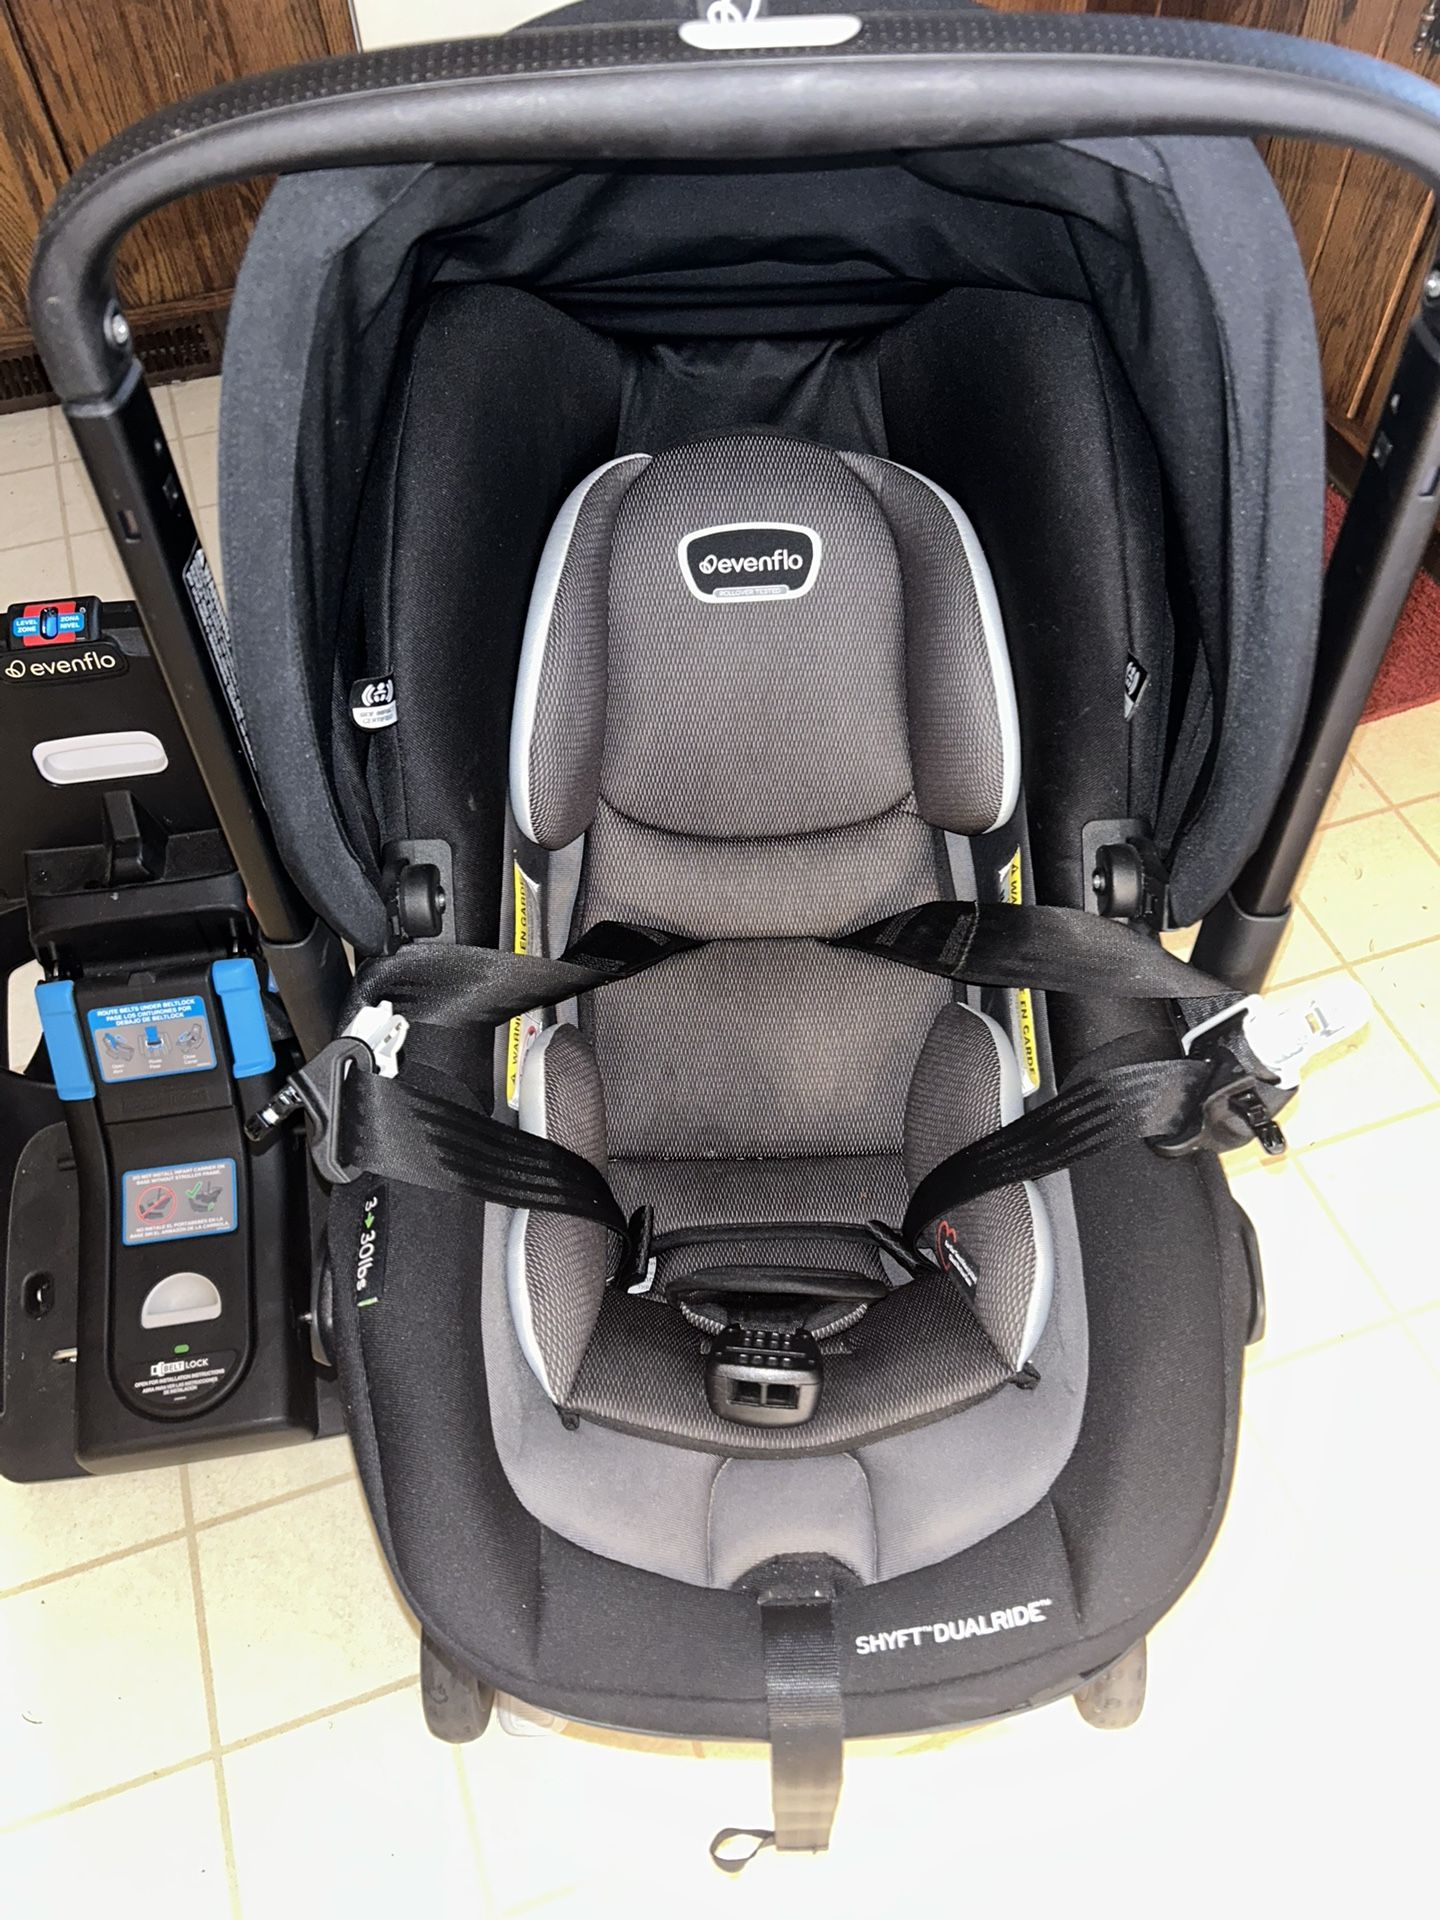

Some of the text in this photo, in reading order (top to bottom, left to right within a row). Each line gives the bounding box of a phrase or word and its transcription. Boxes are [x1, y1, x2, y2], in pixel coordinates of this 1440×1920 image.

[717, 549, 803, 574] evenflo
[16, 619, 38, 627] LEVEL
[30, 651, 116, 677] evenflo
[519, 931, 527, 951] EN
[96, 1008, 118, 1016] ROUTE
[140, 1003, 162, 1011] UNDER
[162, 999, 196, 1008] BELTLOCK
[137, 1008, 177, 1018] CINTURONES
[1020, 1000, 1028, 1020] EN
[116, 1018, 141, 1026] DEBAJO
[152, 1012, 185, 1021] BELTLOCK
[356, 1196, 378, 1291] 3 30lbs
[164, 1358, 209, 1373] BELT LOCK
[158, 1374, 192, 1384] INSTALLATION
[192, 1368, 226, 1378] INSTRUCTIONS
